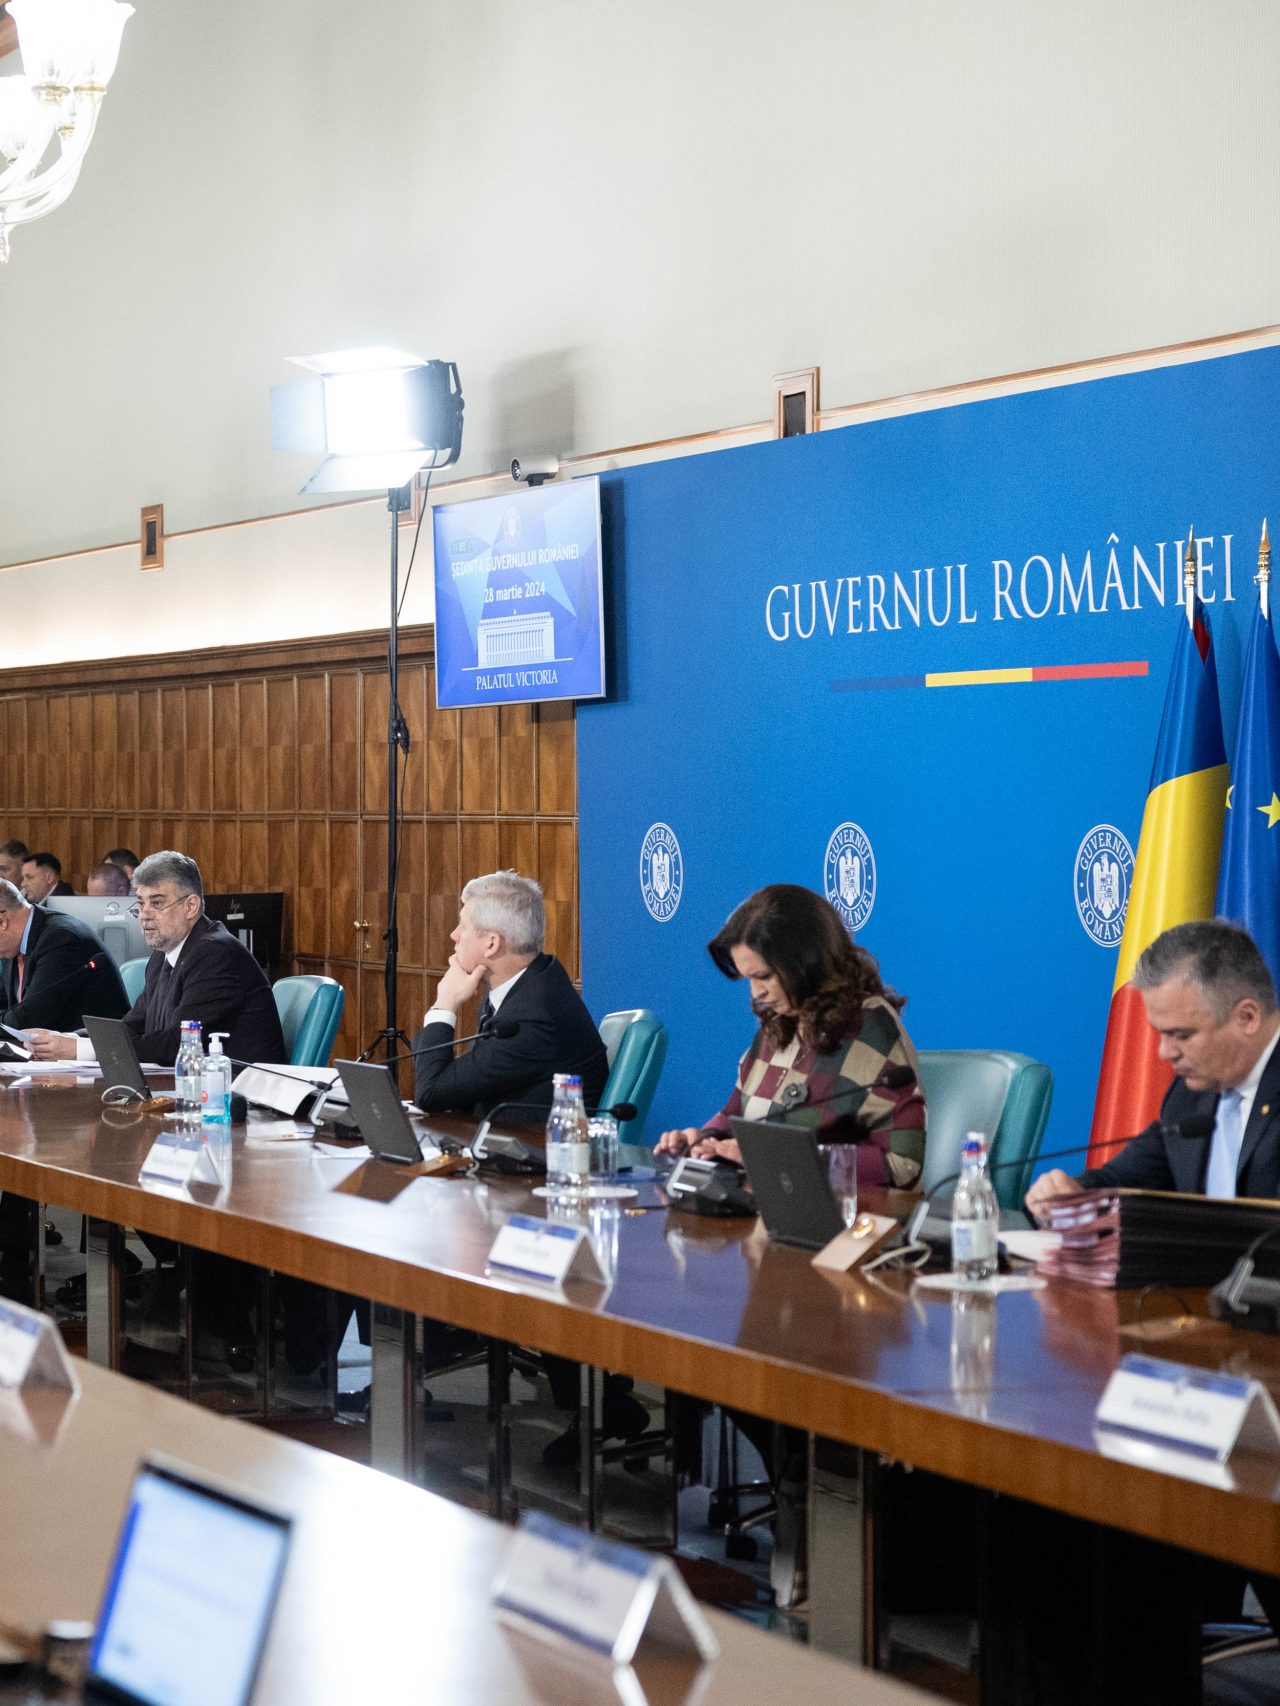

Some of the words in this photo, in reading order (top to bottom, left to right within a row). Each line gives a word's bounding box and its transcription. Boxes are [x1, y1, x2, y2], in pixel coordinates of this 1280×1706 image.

[488, 551, 537, 572] GUVERNULUI
[484, 588, 494, 603] 28
[496, 585, 523, 601] martie
[524, 581, 545, 598] 2024
[765, 563, 977, 641] GUVERNUL
[992, 532, 1236, 621] ROMÂNIEI
[476, 673, 515, 691] PALATUL
[515, 669, 558, 687] VICTORIA
[643, 829, 678, 862] GUVERNUL
[829, 829, 870, 865] GUVERNUL
[1080, 832, 1132, 873] GUVERNUL
